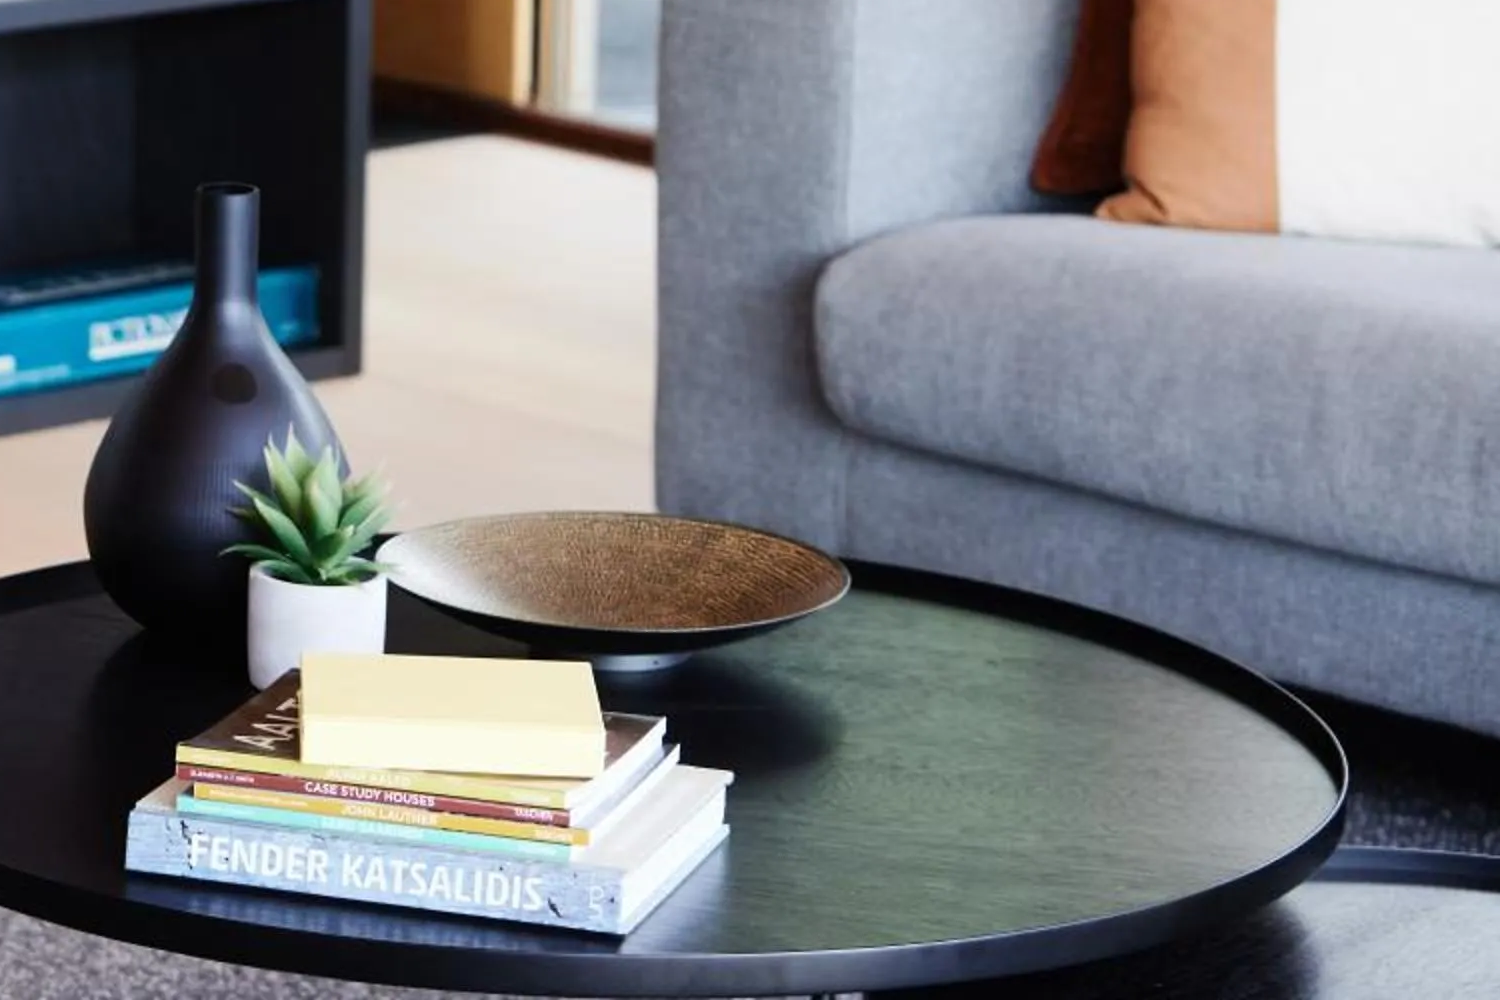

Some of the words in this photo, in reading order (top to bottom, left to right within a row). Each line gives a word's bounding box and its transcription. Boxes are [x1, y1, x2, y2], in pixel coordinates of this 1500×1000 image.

[304, 781, 338, 796] CASE
[341, 785, 382, 800] STUDY
[383, 791, 436, 807] HOUSES
[189, 833, 328, 884] FENDER
[342, 853, 543, 912] KATSALIDIS
